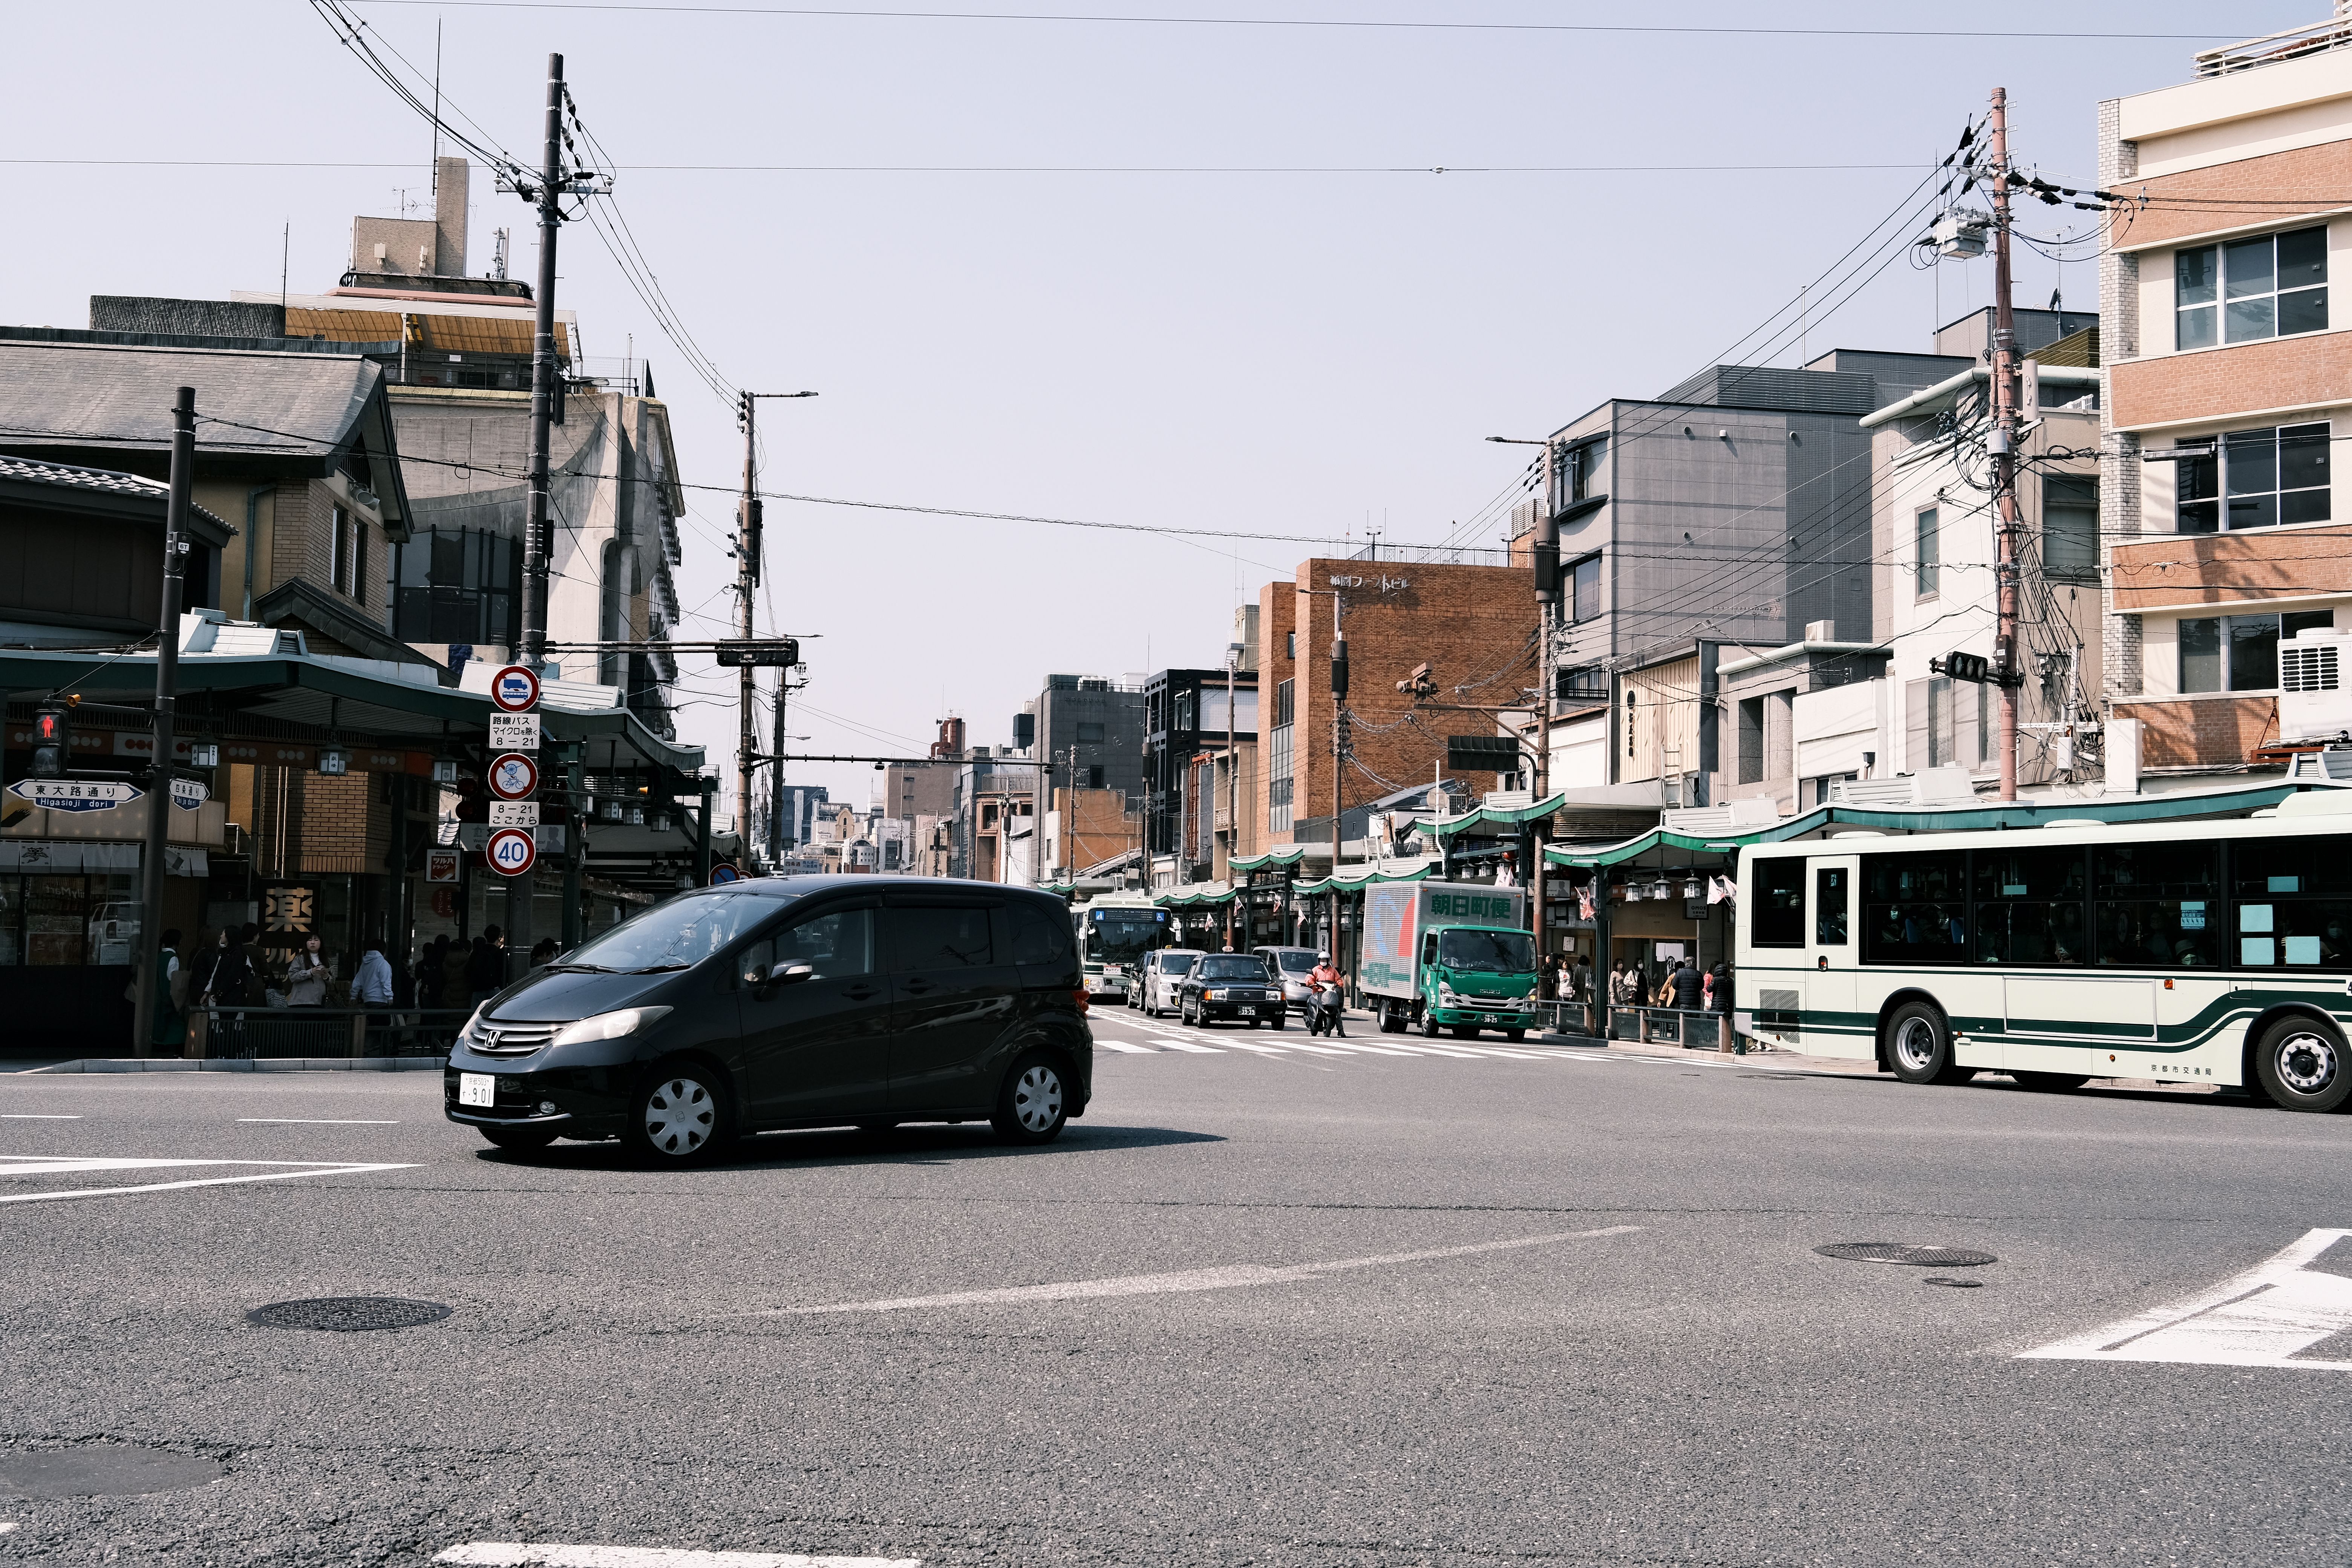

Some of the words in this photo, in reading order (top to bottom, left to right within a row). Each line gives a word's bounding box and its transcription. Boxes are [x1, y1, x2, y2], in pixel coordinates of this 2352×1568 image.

[493, 727, 537, 735] マイクロを除く
[35, 785, 115, 797] 東大路通り
[176, 784, 199, 796] 四条通り
[40, 798, 80, 807] Higasioji
[498, 842, 524, 862] 40
[265, 887, 313, 932] 薬
[1431, 894, 1511, 919] 朝日町便
[2151, 1064, 2212, 1075] 京都市交通局
